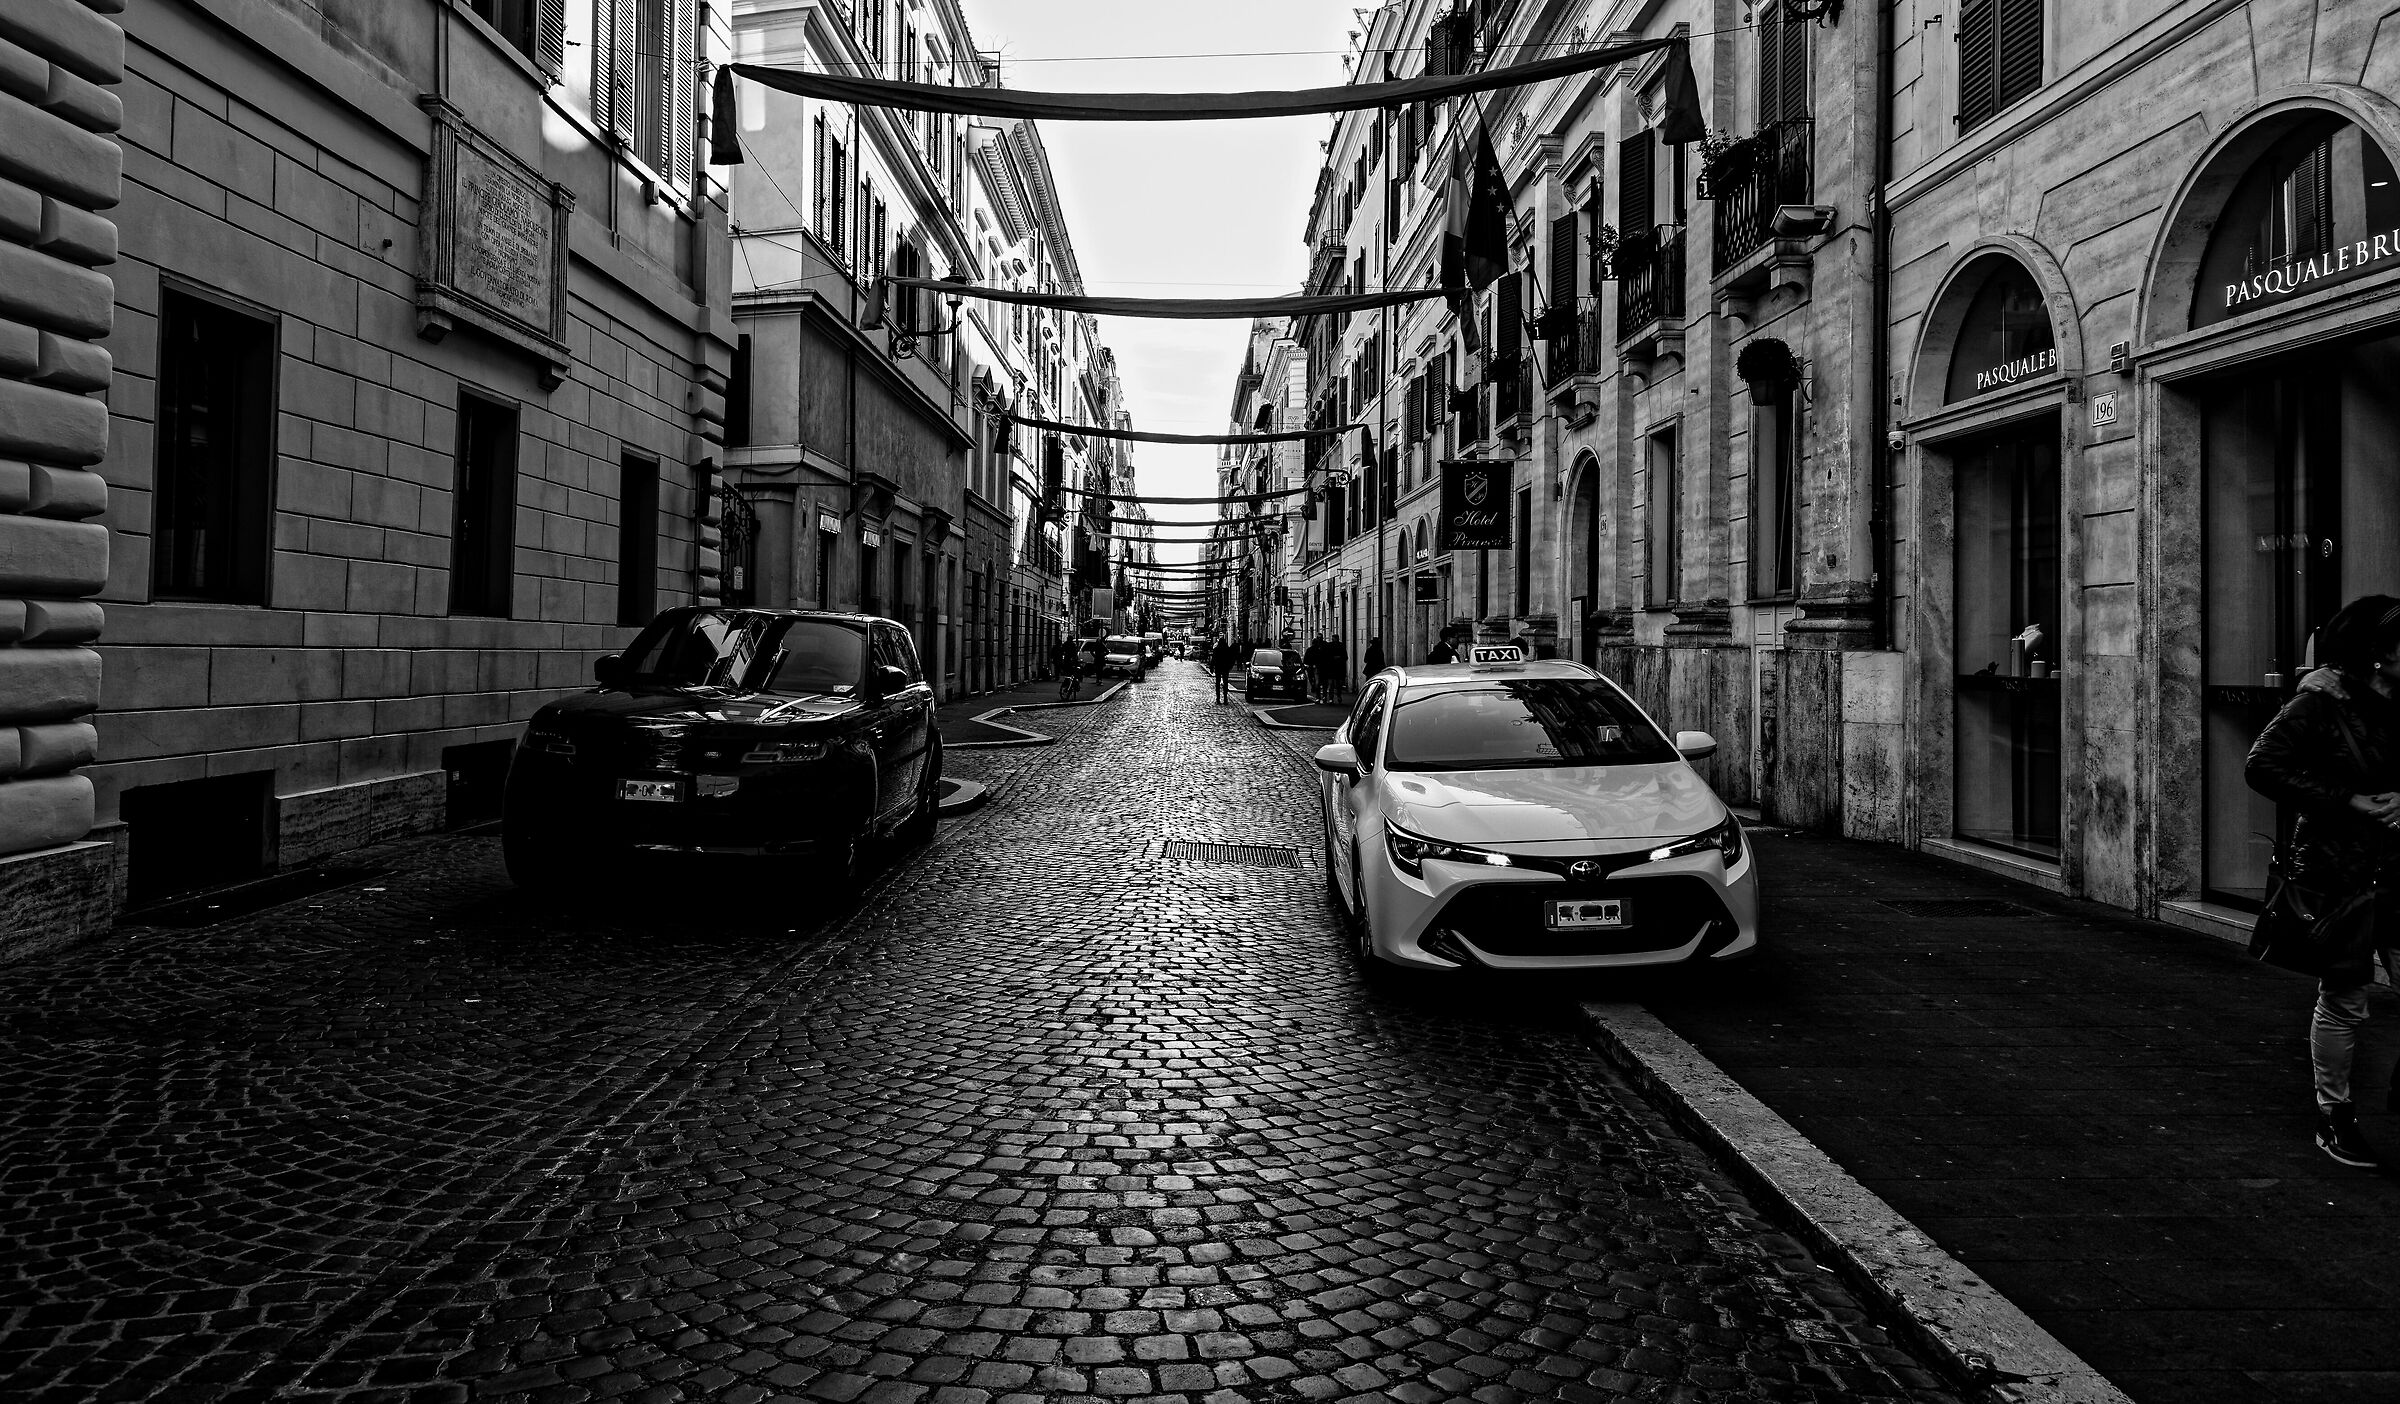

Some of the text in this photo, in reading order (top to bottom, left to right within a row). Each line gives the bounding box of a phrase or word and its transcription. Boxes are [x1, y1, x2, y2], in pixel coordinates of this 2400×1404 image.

[2096, 400, 2113, 420] 196
[1454, 510, 1499, 527] Hotel
[1476, 650, 1518, 661] TAXI
